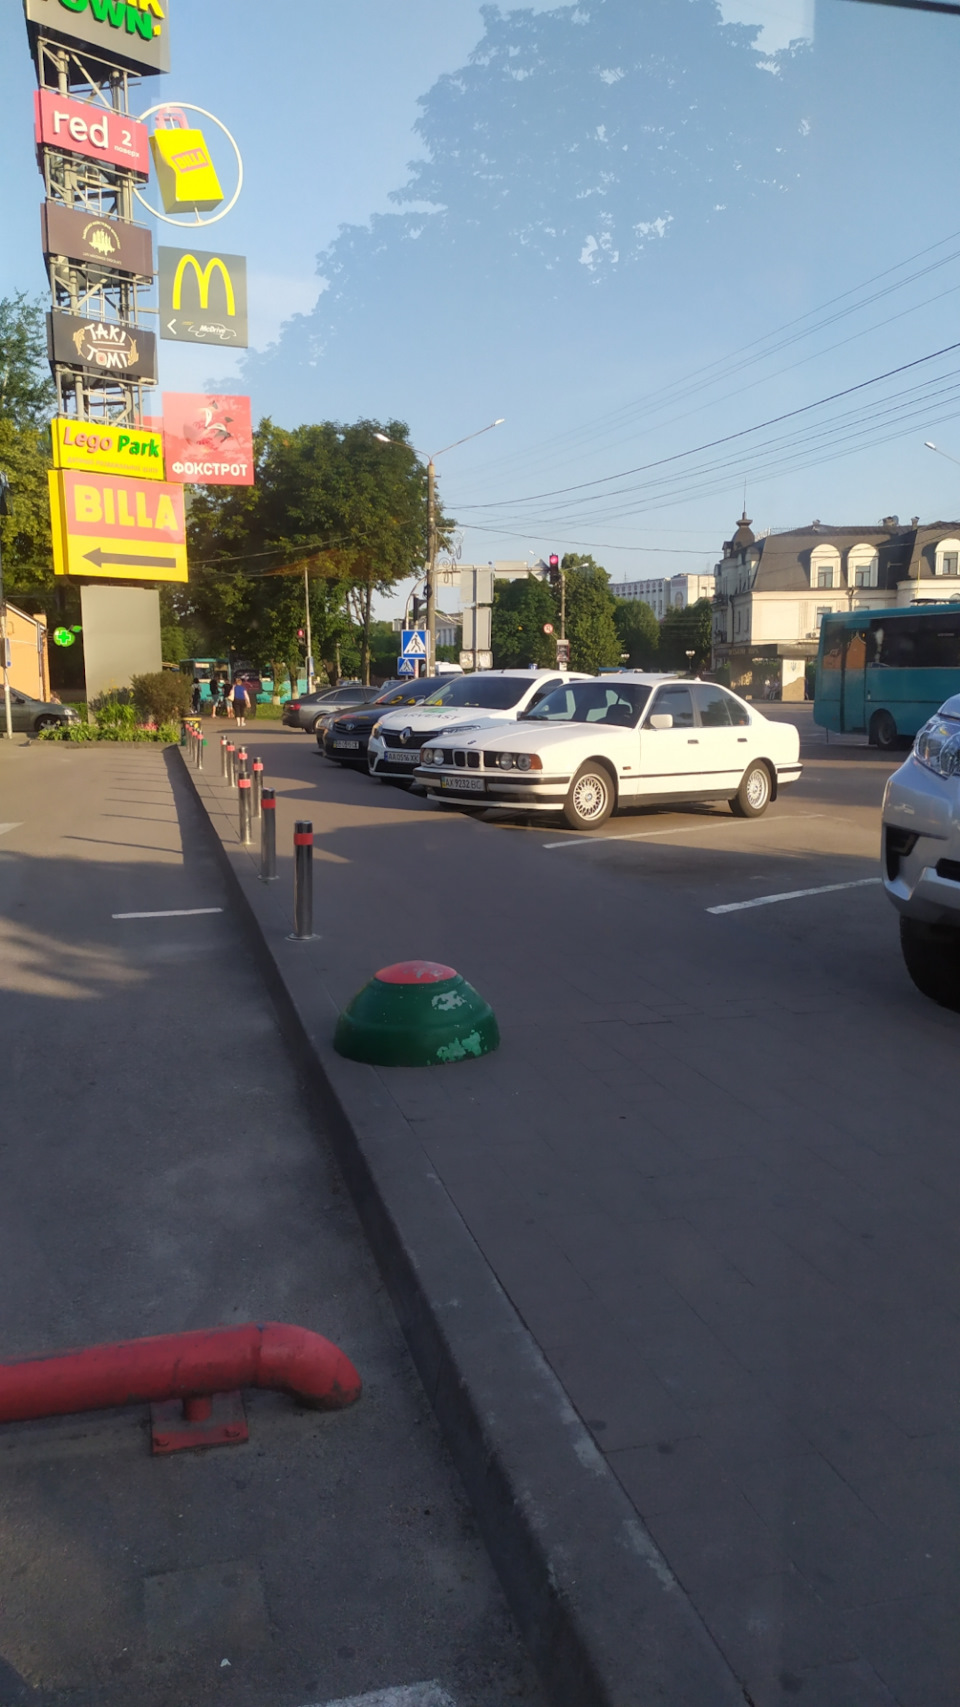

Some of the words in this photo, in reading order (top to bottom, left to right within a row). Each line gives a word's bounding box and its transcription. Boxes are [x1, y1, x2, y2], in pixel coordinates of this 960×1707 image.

[53, 110, 109, 149] red
[121, 130, 132, 147] 2
[175, 151, 208, 171] BILLA
[85, 323, 126, 343] TAKI
[63, 426, 112, 453] Lego
[118, 435, 159, 457] Park
[172, 461, 247, 477] ФОКСТРОТ
[74, 484, 179, 531] BILLA
